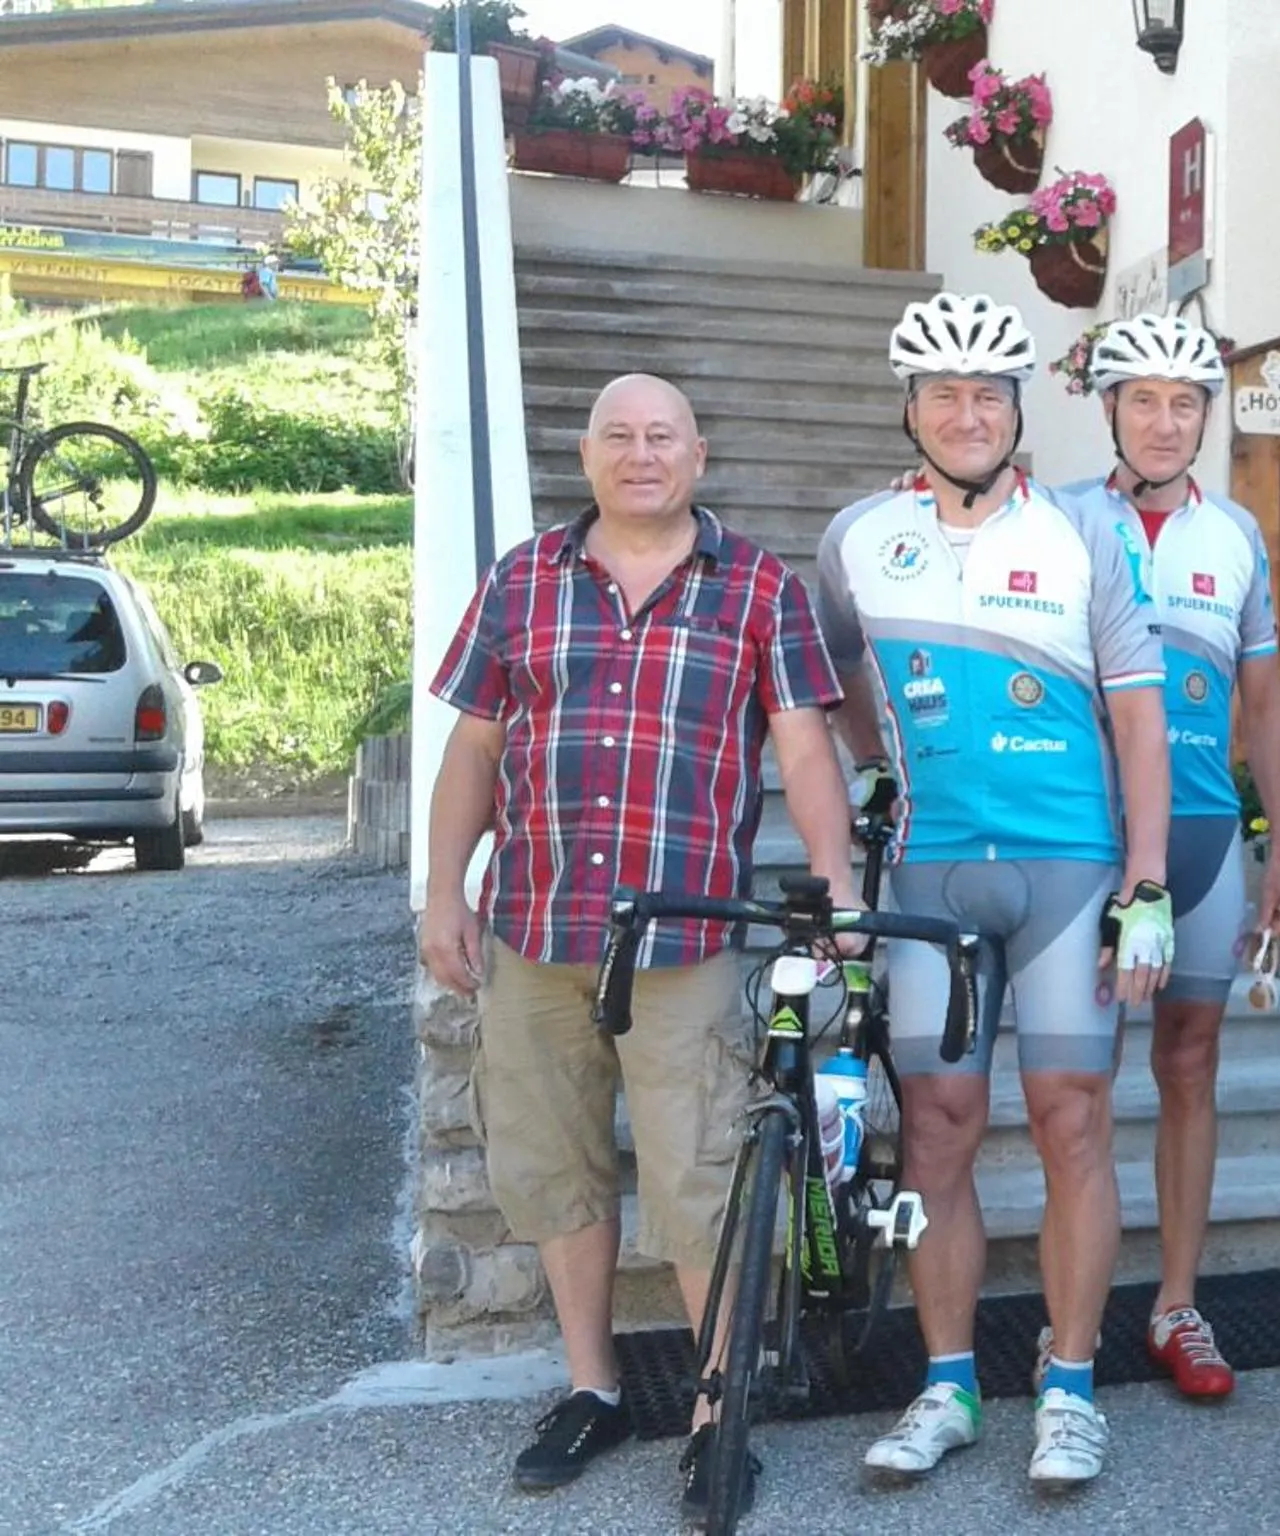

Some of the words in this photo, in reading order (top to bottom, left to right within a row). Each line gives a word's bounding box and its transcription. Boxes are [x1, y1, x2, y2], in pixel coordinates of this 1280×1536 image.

[1183, 141, 1201, 199] H
[979, 595, 1065, 615] SPUERKEESS
[1010, 735, 1067, 752] Cactus
[806, 1176, 840, 1275] MERIDA
